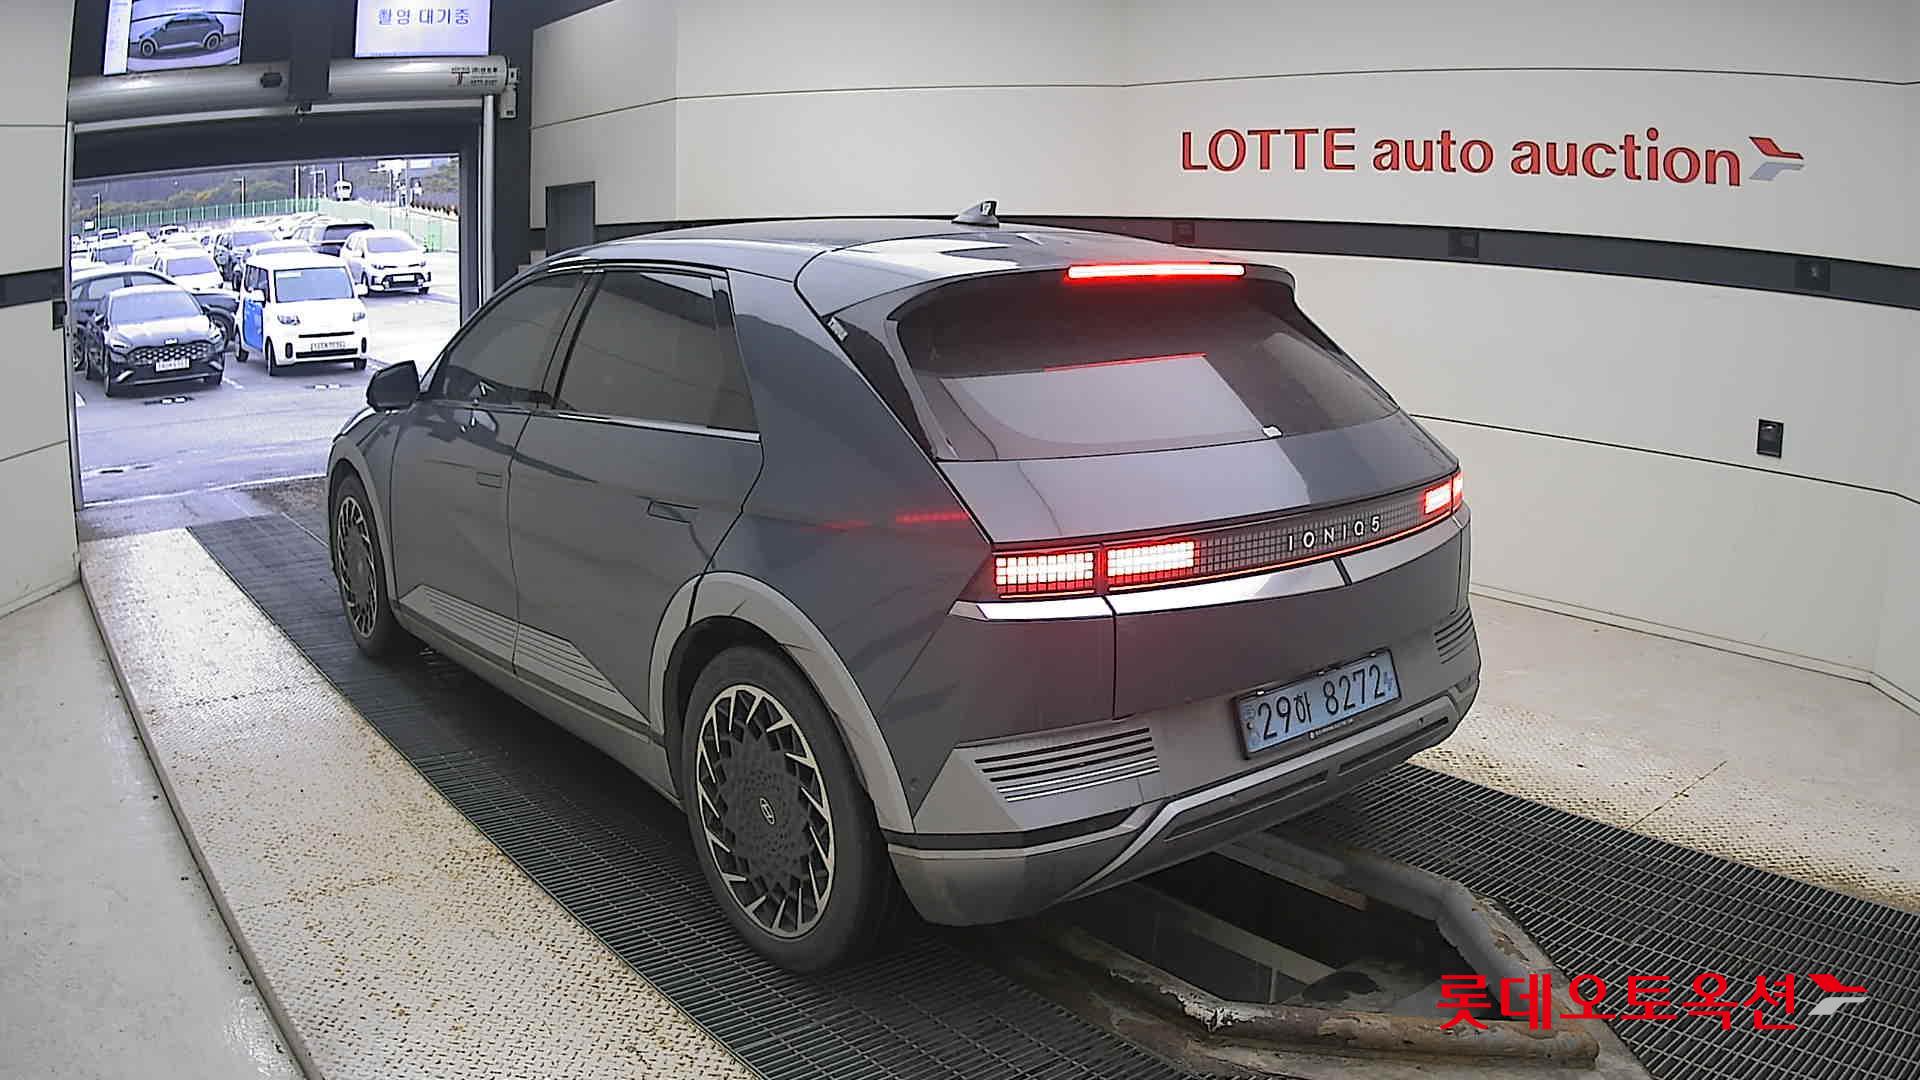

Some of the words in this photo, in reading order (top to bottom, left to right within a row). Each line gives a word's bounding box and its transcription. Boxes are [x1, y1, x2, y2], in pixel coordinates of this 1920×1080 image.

[419, 8, 469, 25] 대기중
[1182, 127, 1356, 172] LOTTE
[1372, 129, 1495, 174] auto
[1510, 127, 1742, 187] auction
[1257, 691, 1313, 741] 29하
[1322, 664, 1386, 716] 8272
